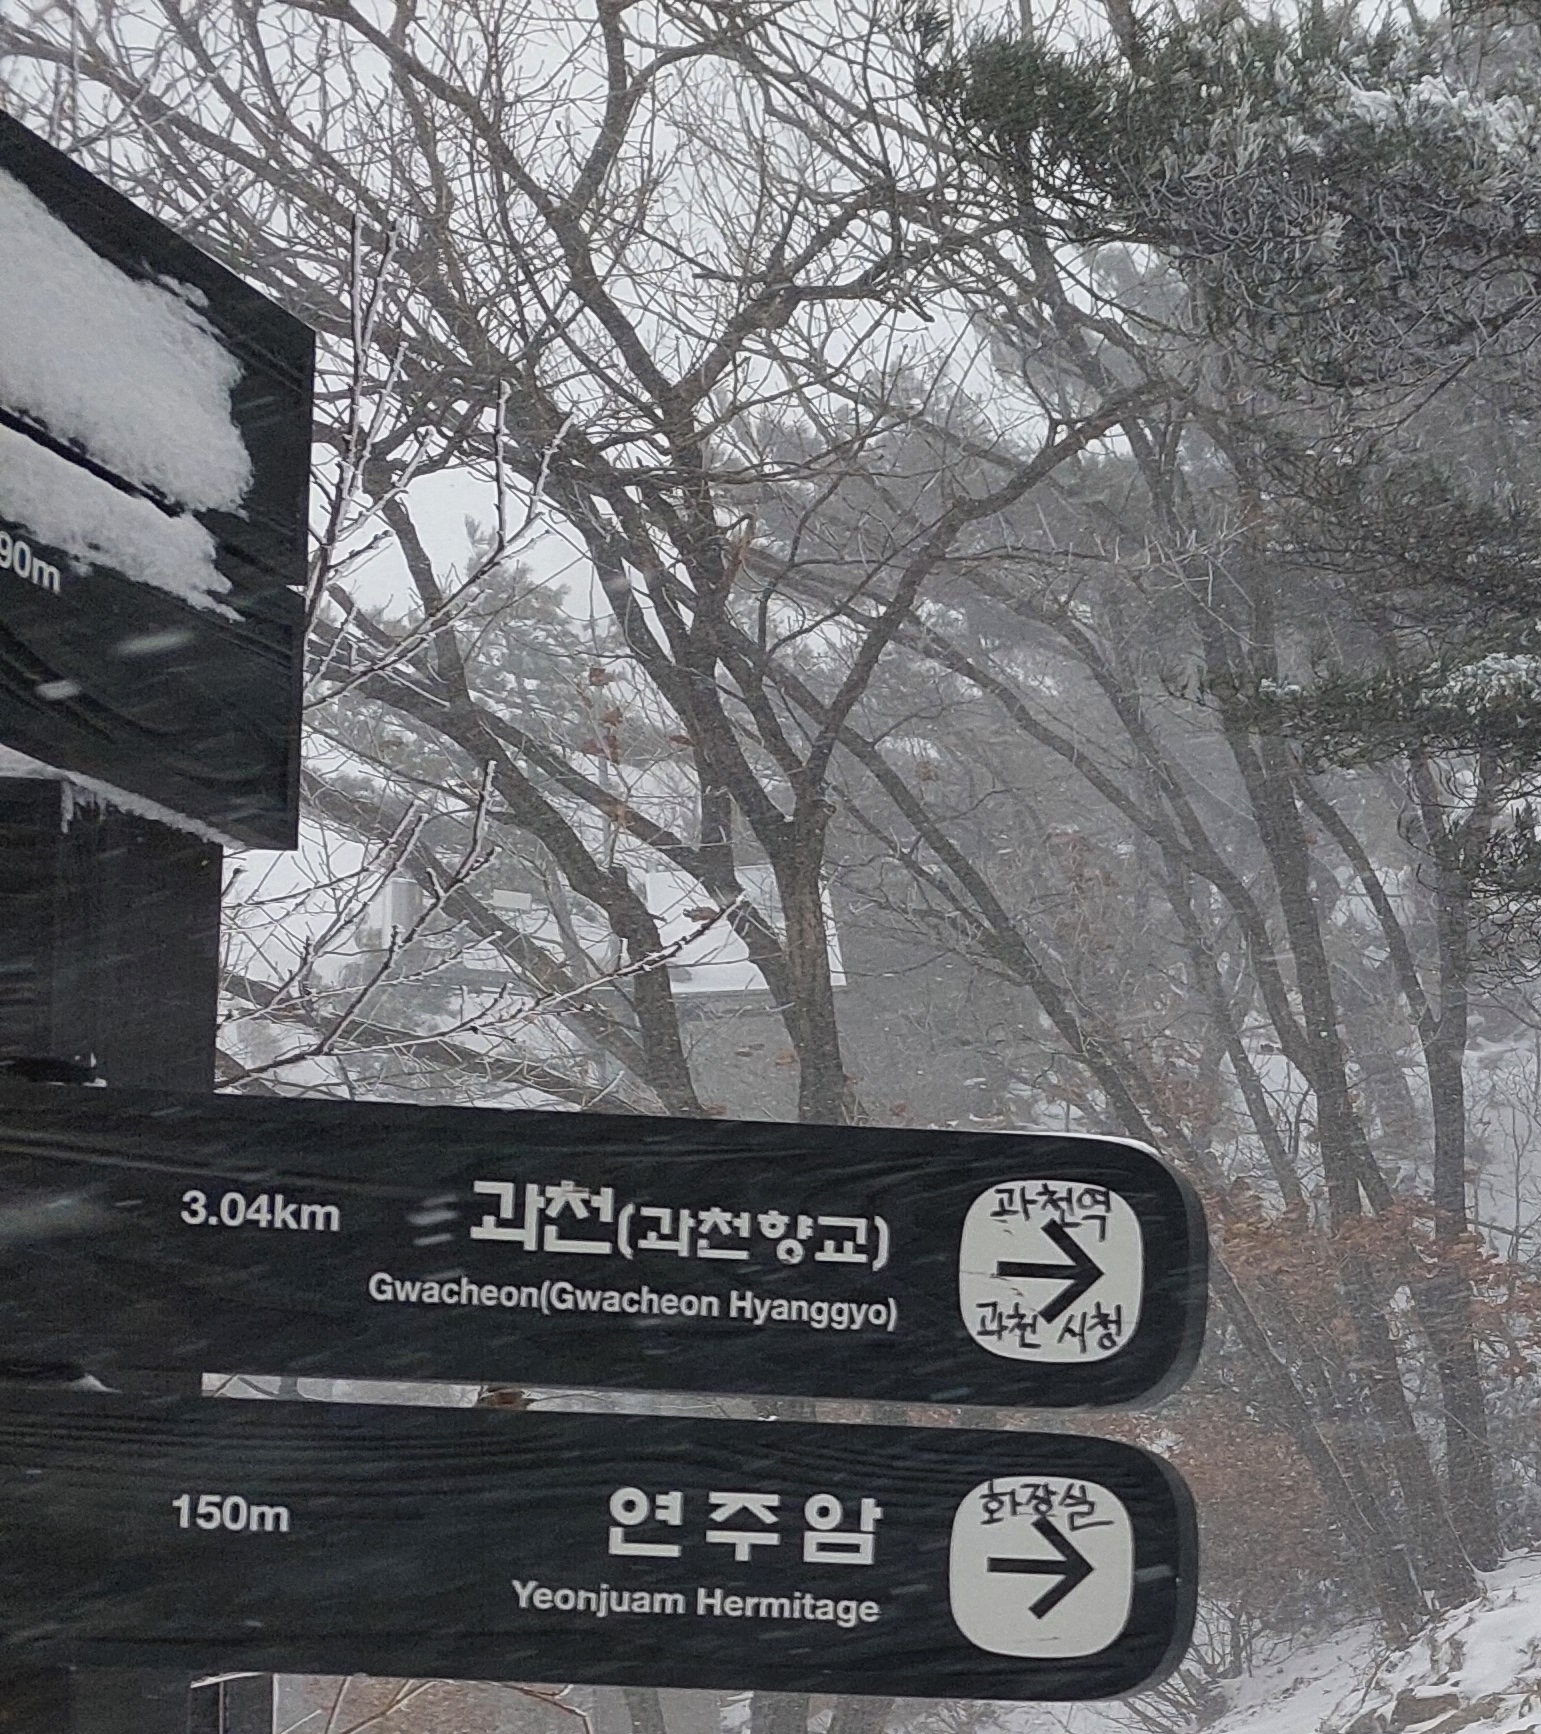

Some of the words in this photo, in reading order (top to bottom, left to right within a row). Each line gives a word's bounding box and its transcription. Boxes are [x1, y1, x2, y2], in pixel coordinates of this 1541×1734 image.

[181, 1190, 340, 1231] 3.04km
[470, 1181, 889, 1271] 과천(과천향교)
[990, 1182, 1111, 1242] 과천역
[369, 1272, 719, 1316] Gwacheon(Gwacheon
[729, 1290, 897, 1332] Hyanggyo)
[976, 1301, 1041, 1349] 과천
[1057, 1301, 1121, 1353] 시청
[172, 1493, 289, 1532] 150m
[979, 1479, 1114, 1531] 화장실
[512, 1580, 685, 1617] Yeonjuam
[697, 1587, 880, 1628] Hermitage
